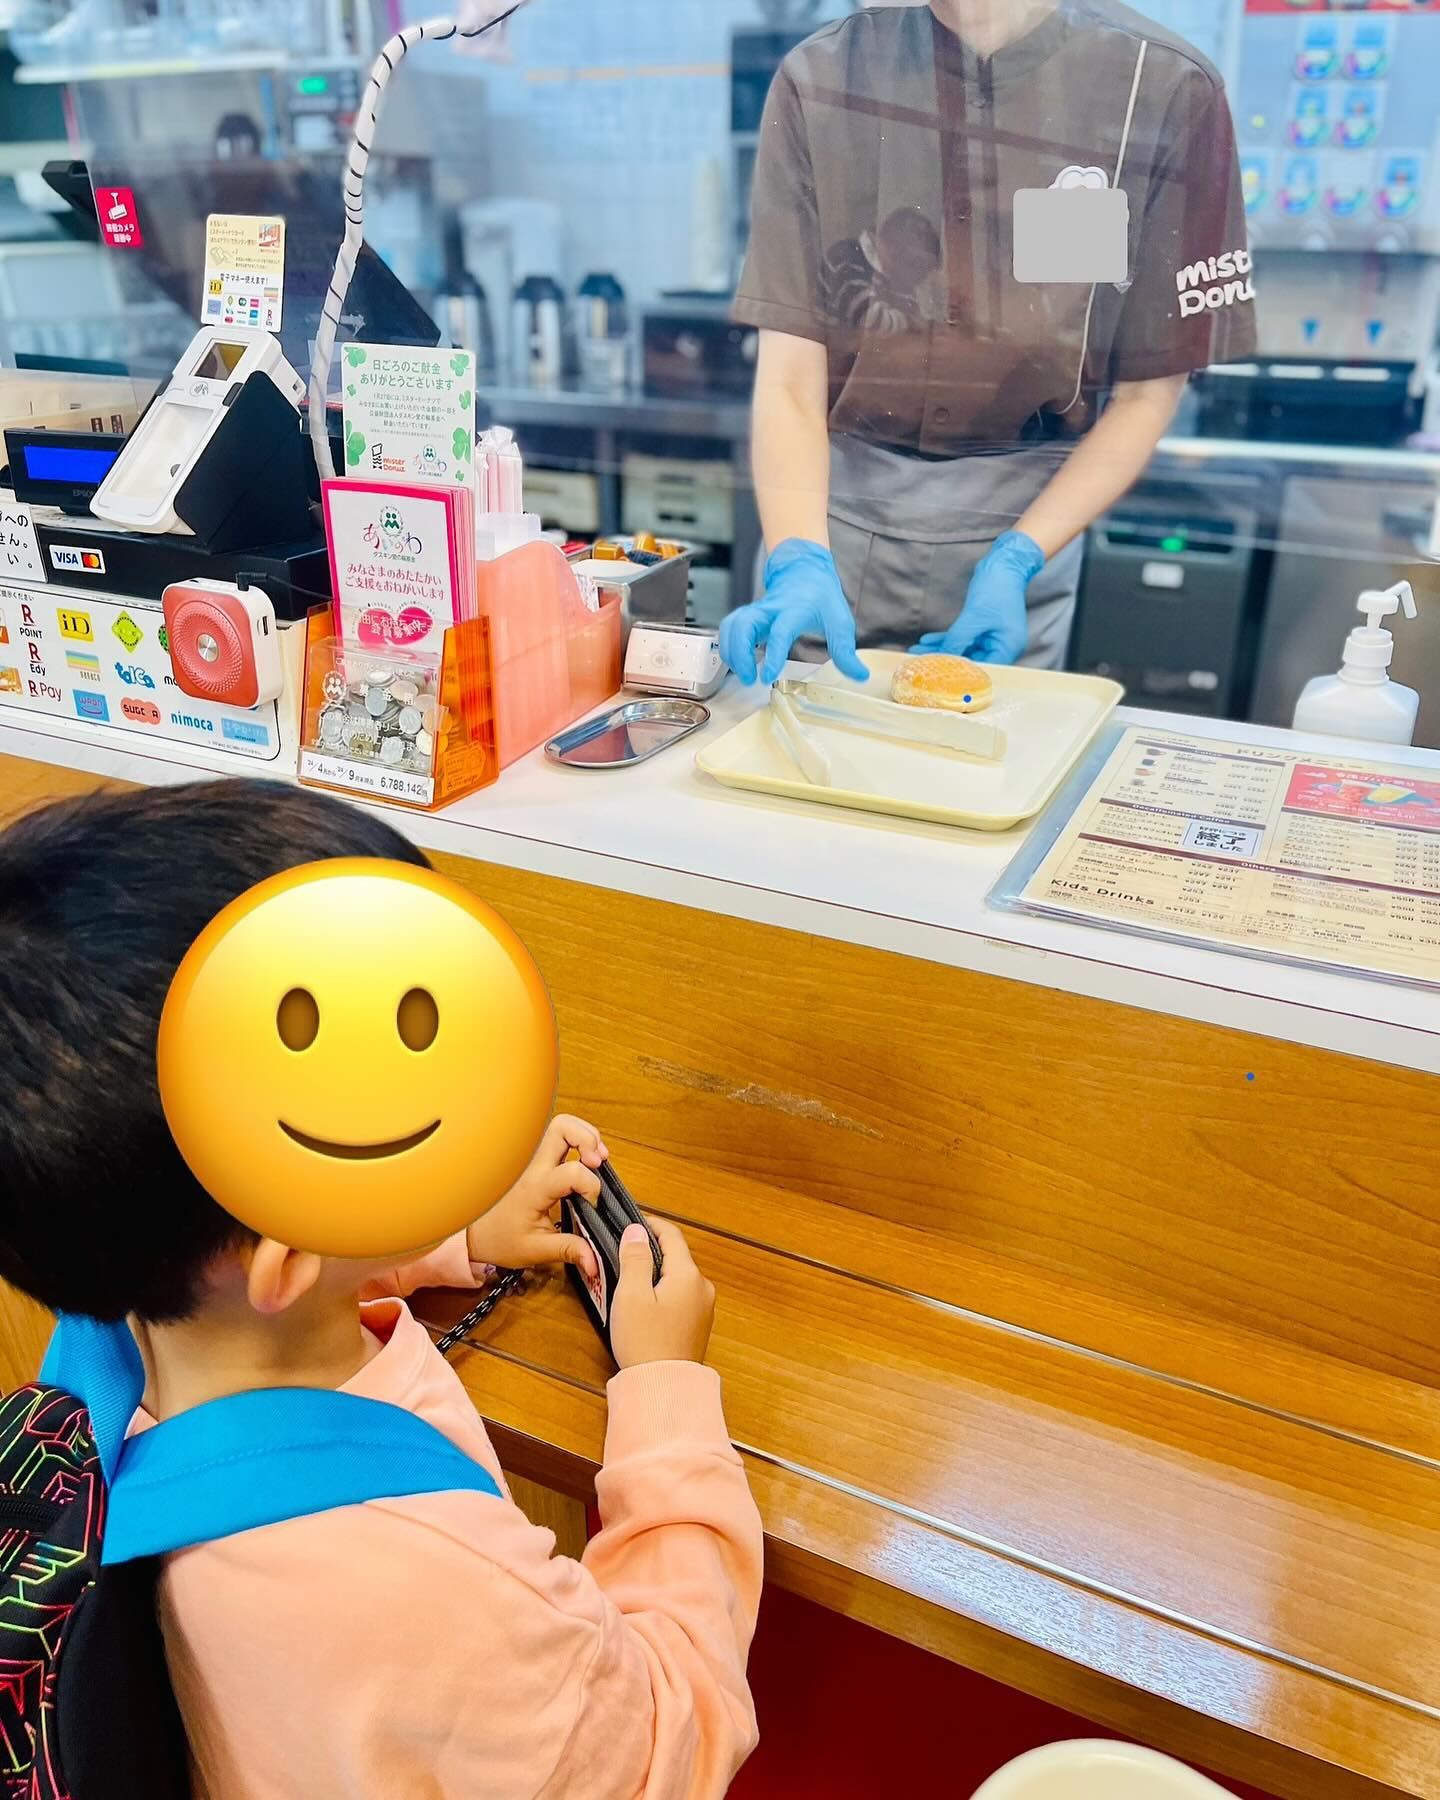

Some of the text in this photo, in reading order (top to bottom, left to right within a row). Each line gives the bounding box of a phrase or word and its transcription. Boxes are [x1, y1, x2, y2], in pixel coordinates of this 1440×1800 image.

[373, 359, 440, 375] 日ごろのご献金
[360, 373, 454, 390] ありがとうございます
[54, 551, 79, 565] VISA
[346, 563, 442, 585] みなさまのあたたかい
[345, 576, 444, 600] ご支援をおねがいします
[21, 604, 34, 623] R
[20, 627, 42, 639] POINT
[62, 613, 90, 635] iD
[28, 642, 41, 661] R
[30, 663, 46, 676] Edy
[40, 682, 62, 702] Pay
[171, 711, 213, 732] nimoca
[1237, 748, 1363, 768] ドリンクメニュー
[1194, 839, 1244, 852] しました
[1196, 830, 1247, 845] 終了
[1241, 862, 1277, 872] Others
[1051, 878, 1154, 905] Kids Drinks
